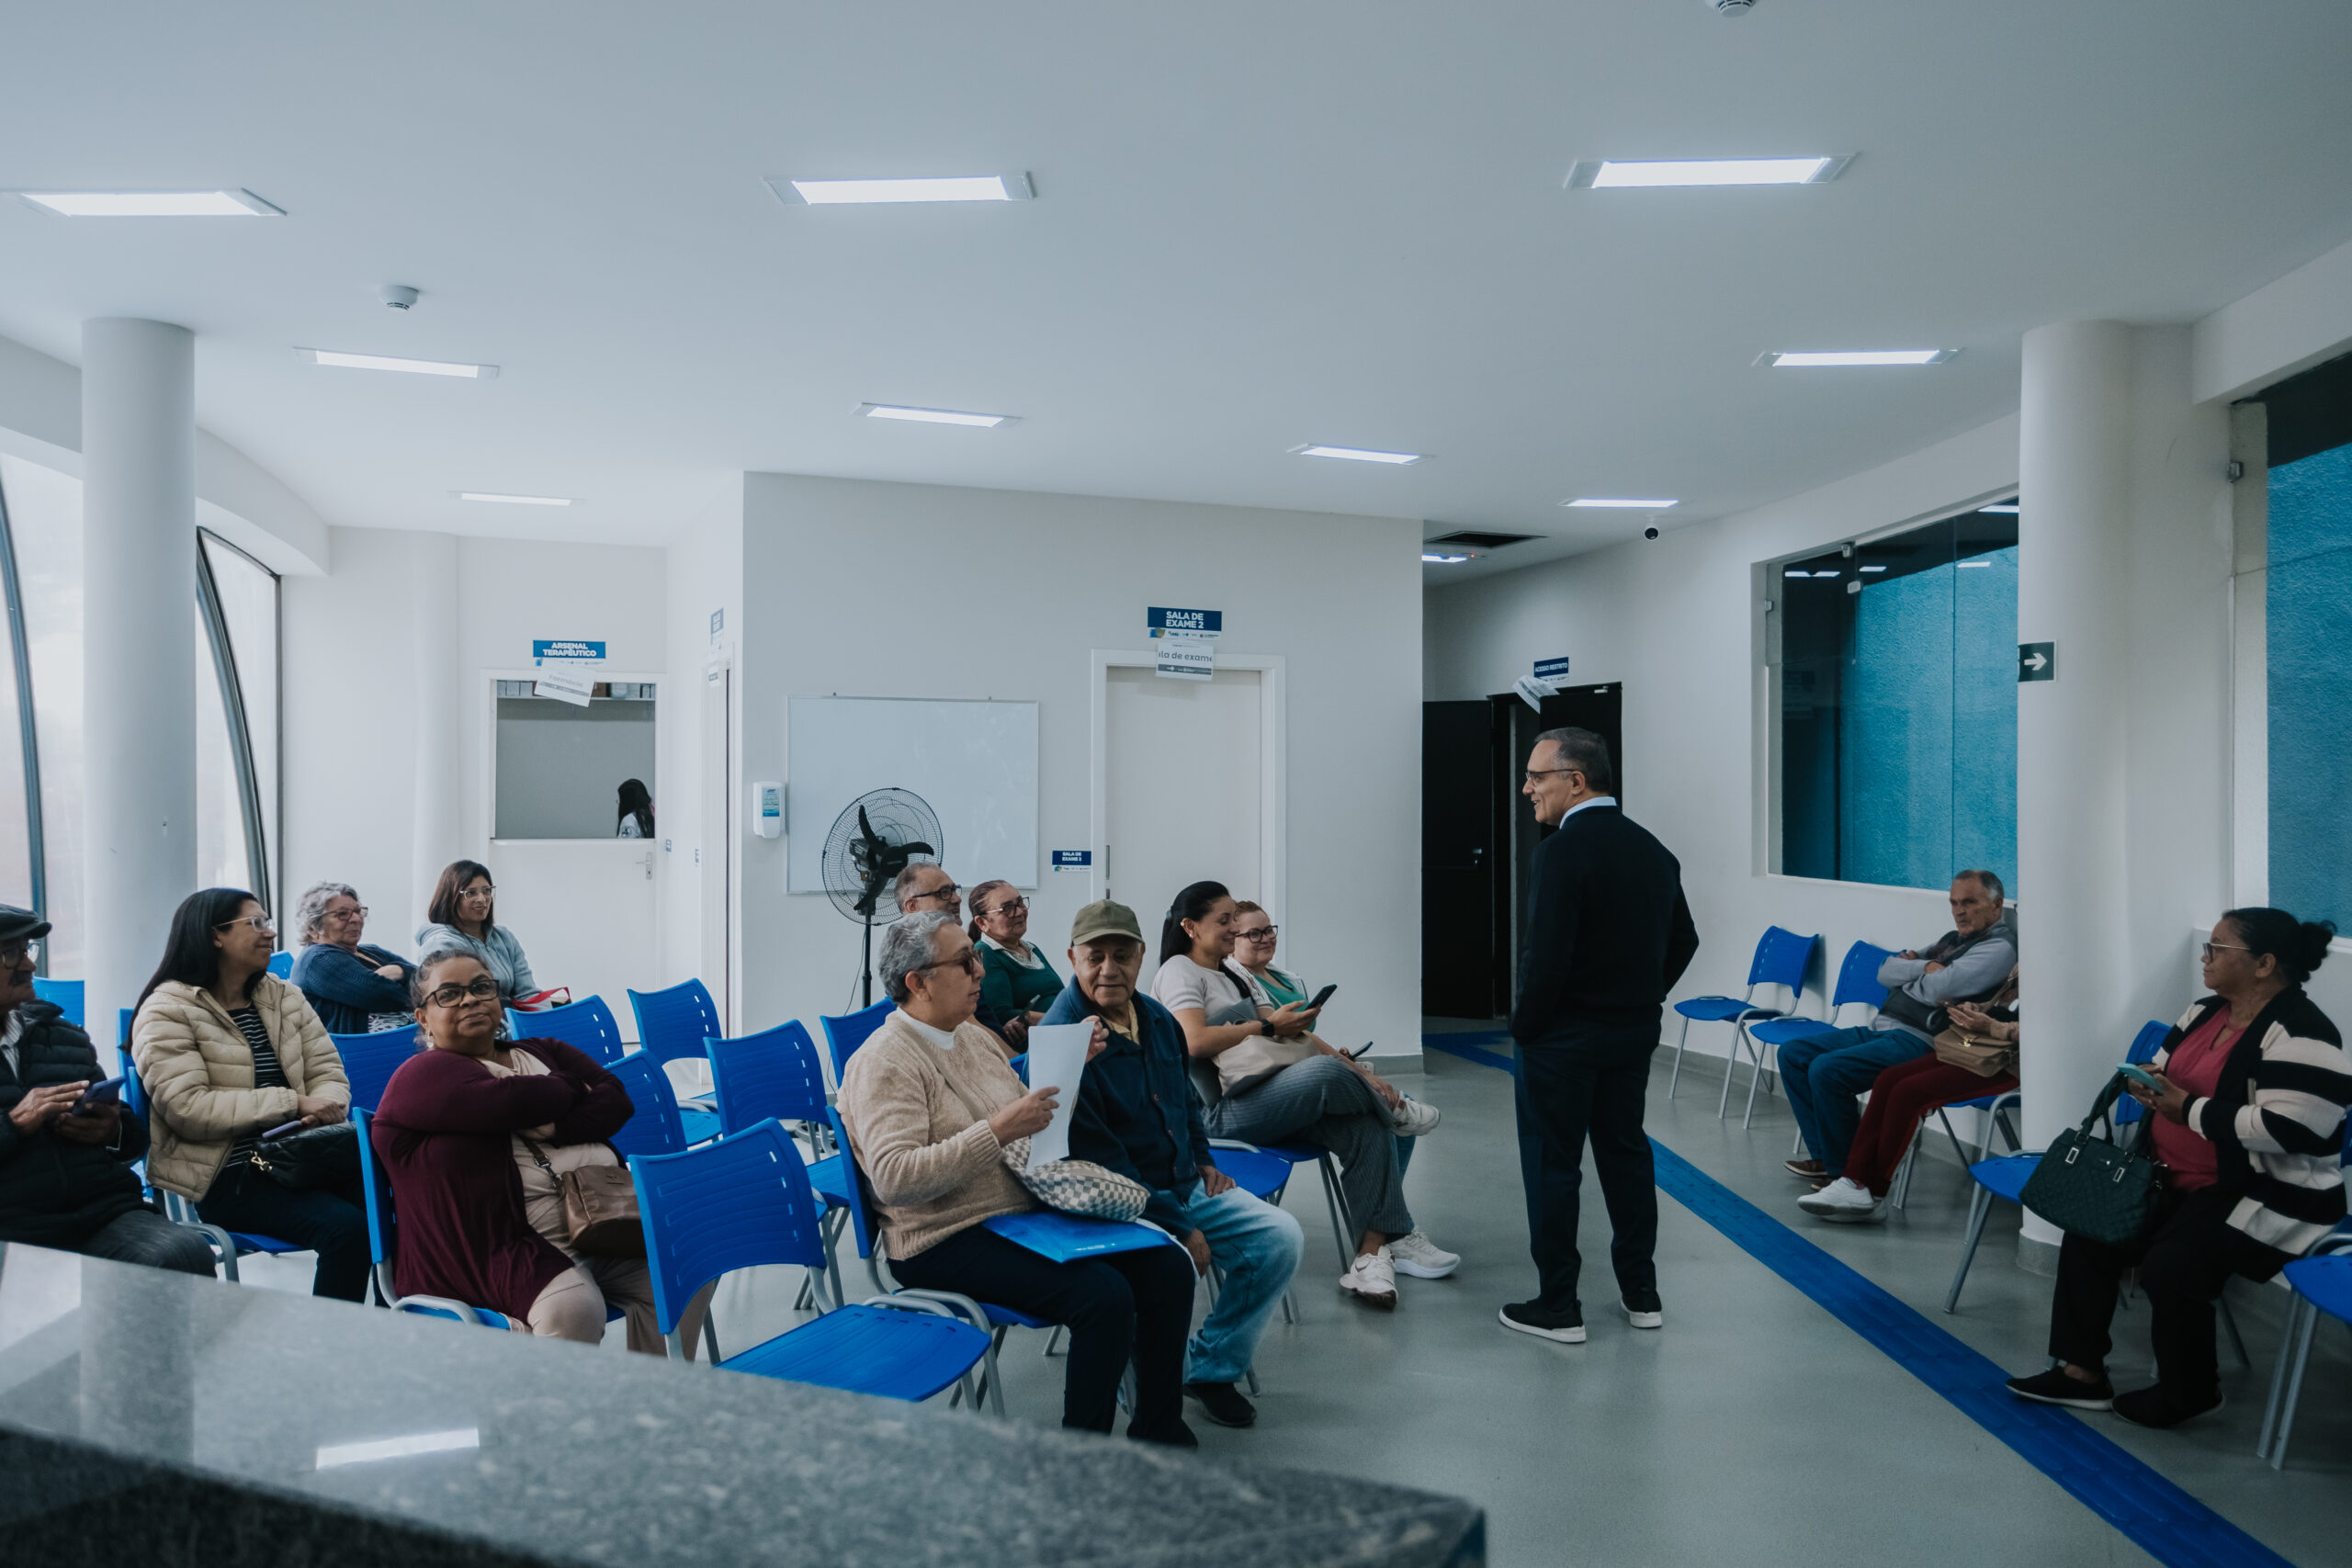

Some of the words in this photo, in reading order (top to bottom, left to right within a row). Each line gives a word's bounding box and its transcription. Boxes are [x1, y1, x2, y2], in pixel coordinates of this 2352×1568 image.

[1166, 611, 1190, 620] SALA
[1191, 613, 1204, 621] DE
[1166, 619, 1197, 628] EXAME
[1197, 621, 1204, 629] 2
[551, 642, 588, 650] ARSENAL
[542, 648, 597, 657] TERAPÊUTICO
[1171, 650, 1183, 660] de
